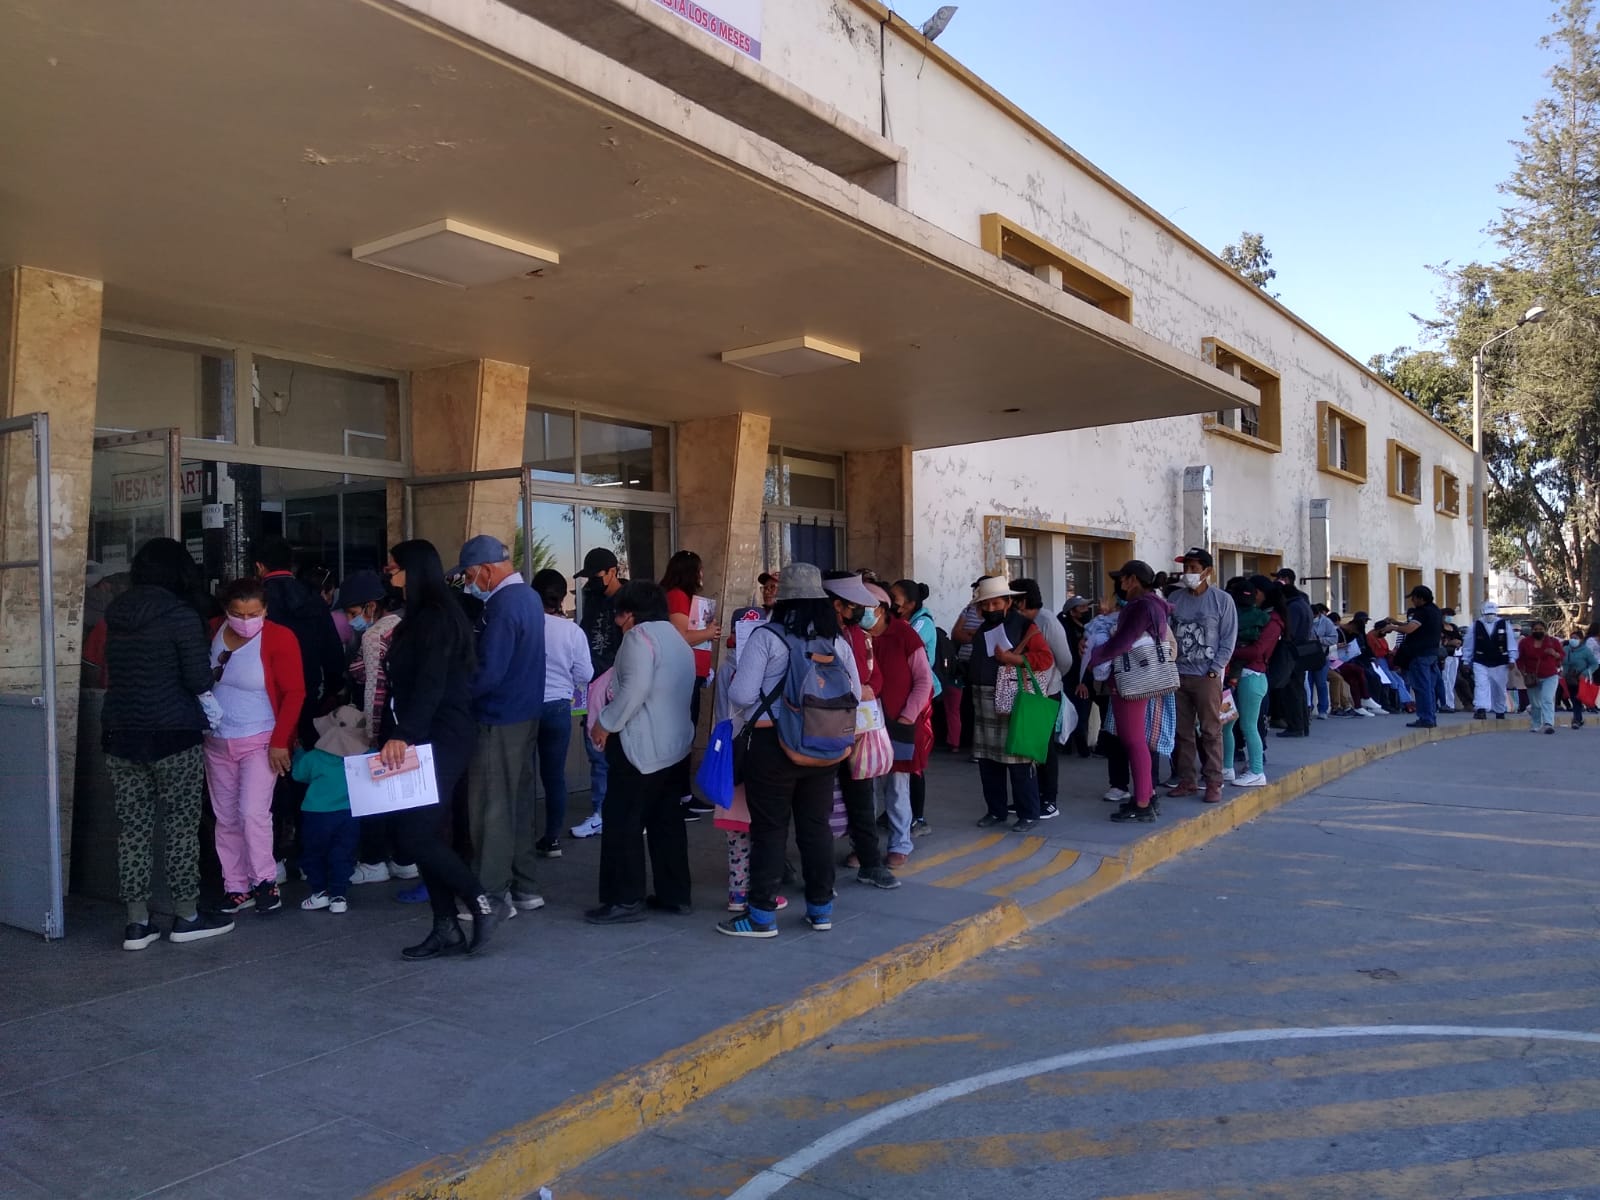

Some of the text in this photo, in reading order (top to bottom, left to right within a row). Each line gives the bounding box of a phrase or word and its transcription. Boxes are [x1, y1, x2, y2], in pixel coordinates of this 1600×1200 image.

[688, 3, 708, 28] LOS
[710, 17, 717, 33] 6
[719, 21, 751, 53] MESES
[113, 478, 149, 504] MESA
